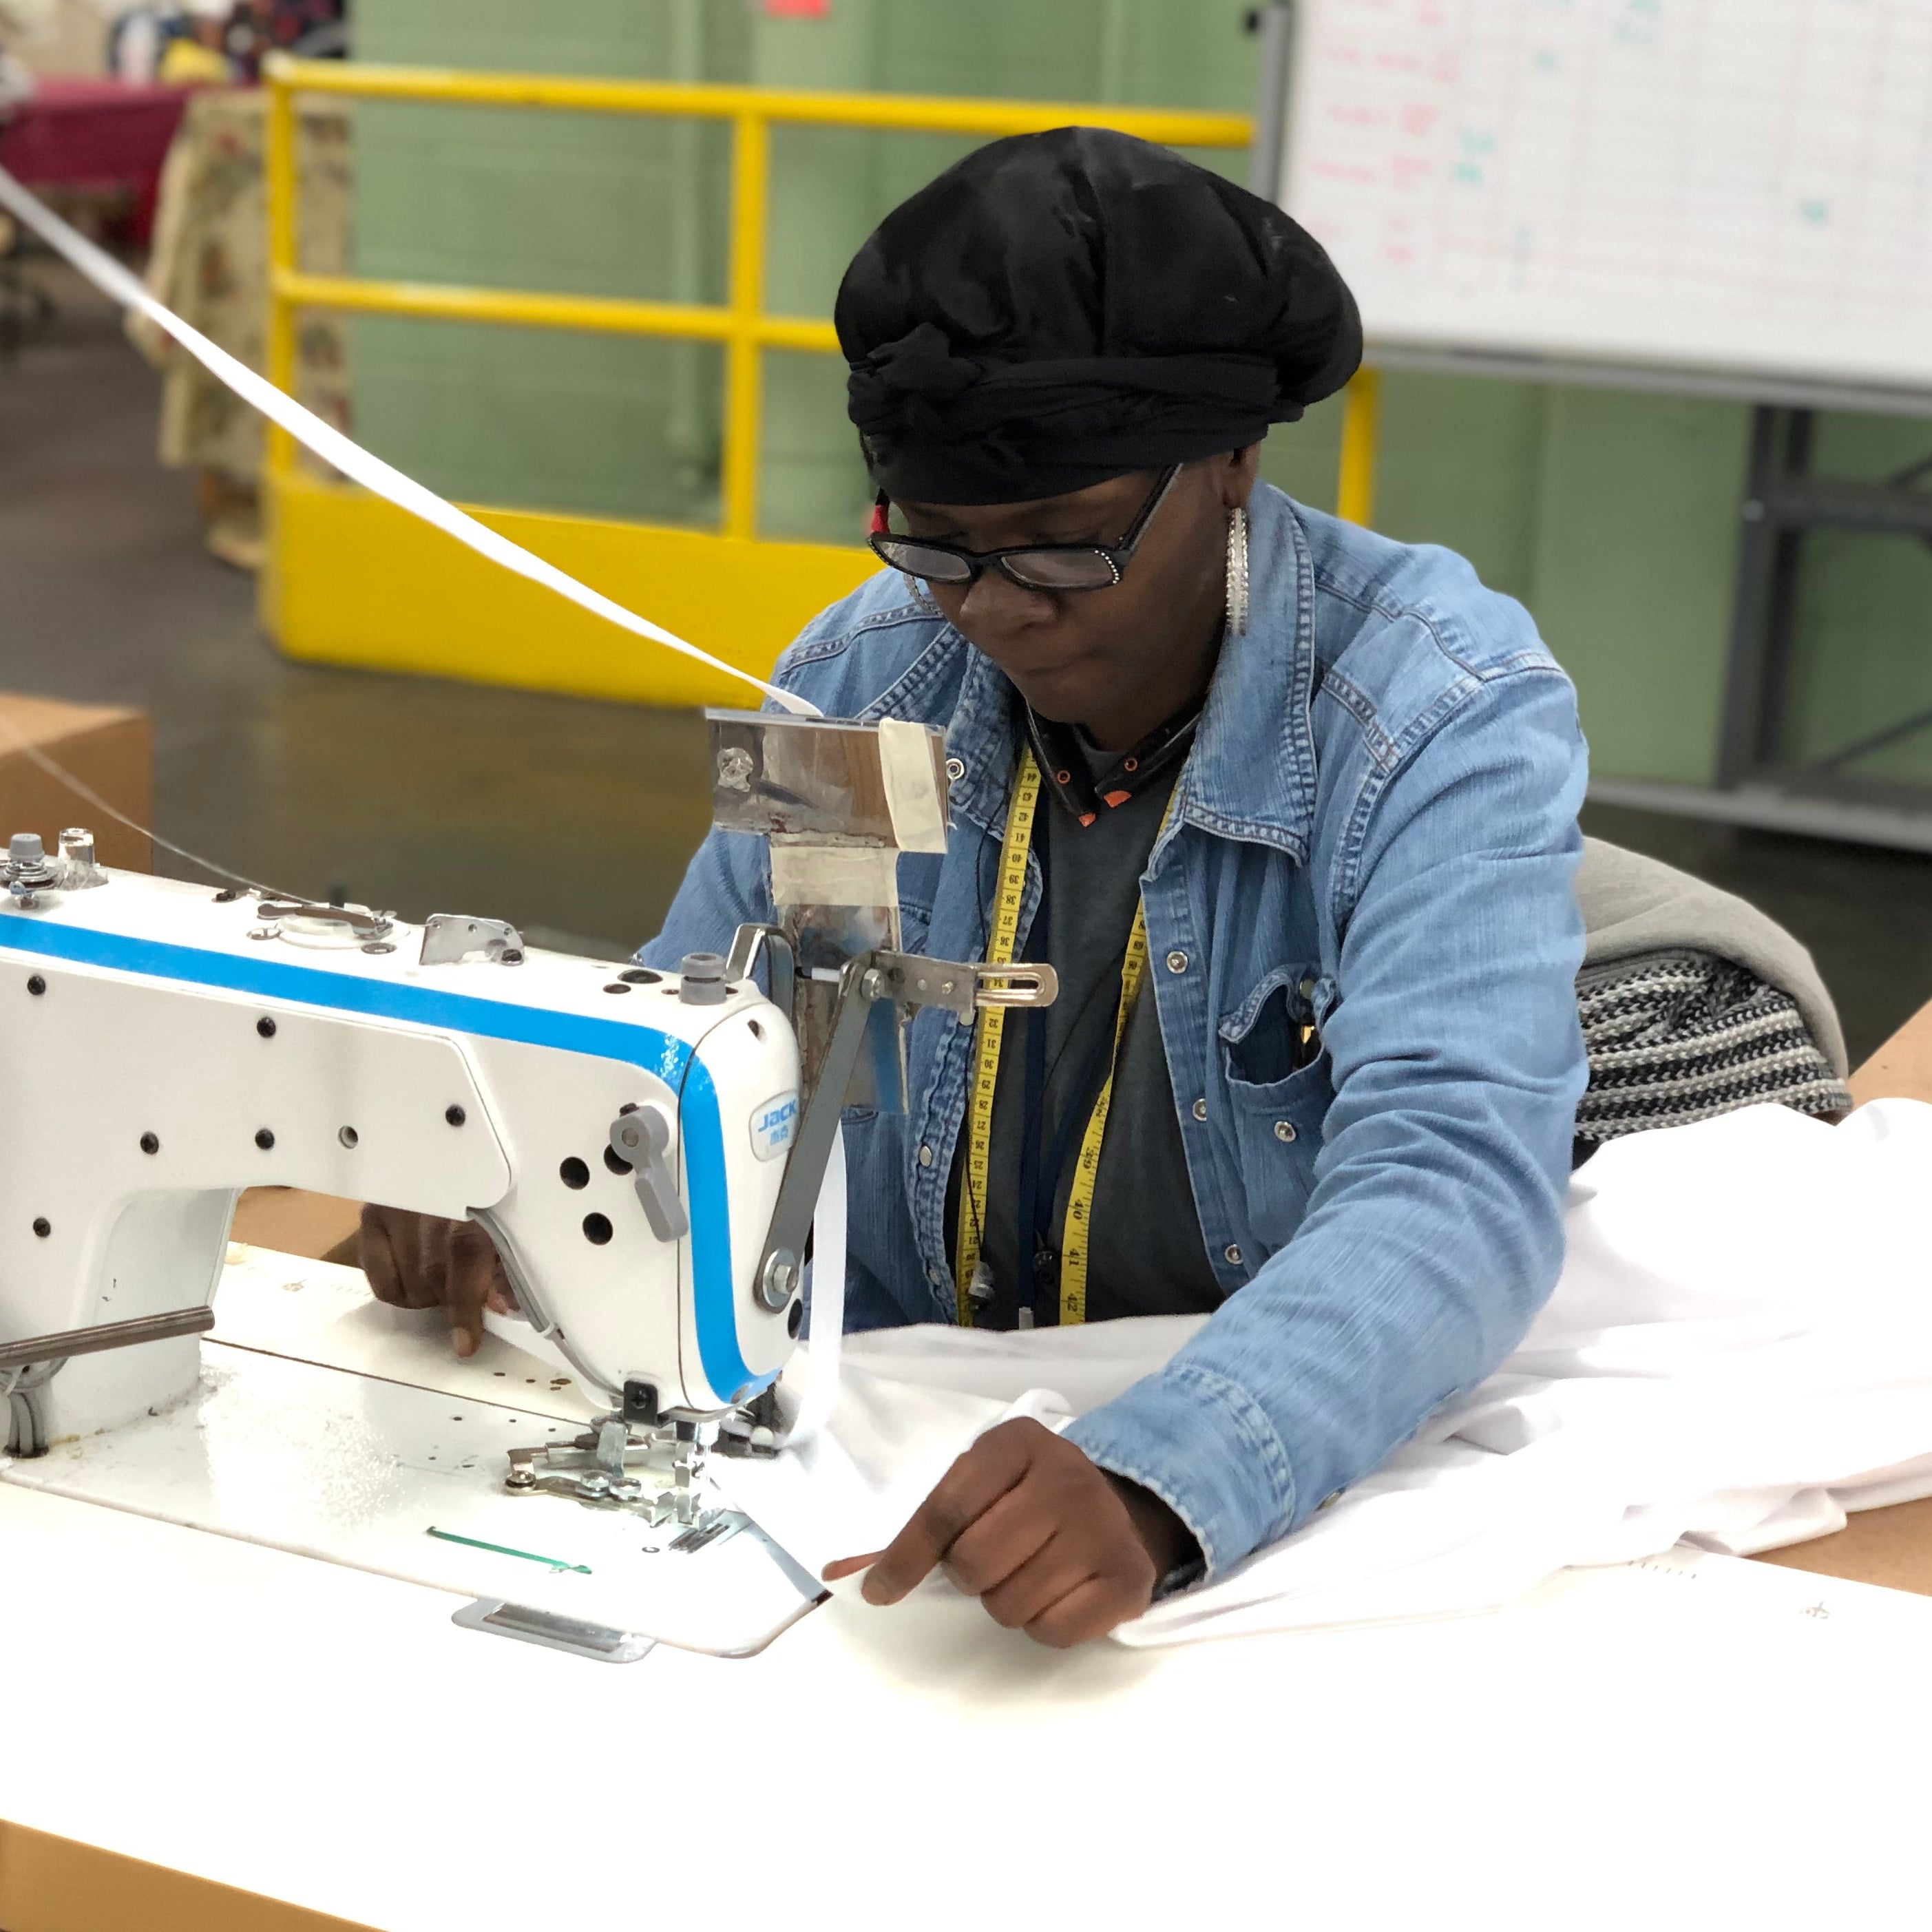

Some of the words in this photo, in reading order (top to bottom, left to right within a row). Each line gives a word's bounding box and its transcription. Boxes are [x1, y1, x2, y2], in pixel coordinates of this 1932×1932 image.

[1018, 812, 1029, 821] 42
[1016, 832, 1025, 843] 41
[1012, 854, 1022, 863] 40
[1009, 874, 1019, 884] 39
[1006, 894, 1016, 905] 38
[1002, 916, 1013, 925] 37
[1000, 936, 1009, 947] 36
[994, 978, 1003, 987] 34
[989, 1018, 998, 1029] 32
[987, 1039, 996, 1049] 31
[985, 1060, 994, 1069] 30
[981, 1080, 991, 1090] 29
[979, 1100, 989, 1110] 28
[977, 1120, 986, 1131] 27
[976, 1140, 985, 1150] 26
[1083, 1147, 1094, 1169] 39
[974, 1159, 984, 1170] 25
[1073, 1199, 1084, 1220] 40
[1069, 1248, 1080, 1266] 41
[1068, 1293, 1078, 1312] 42
